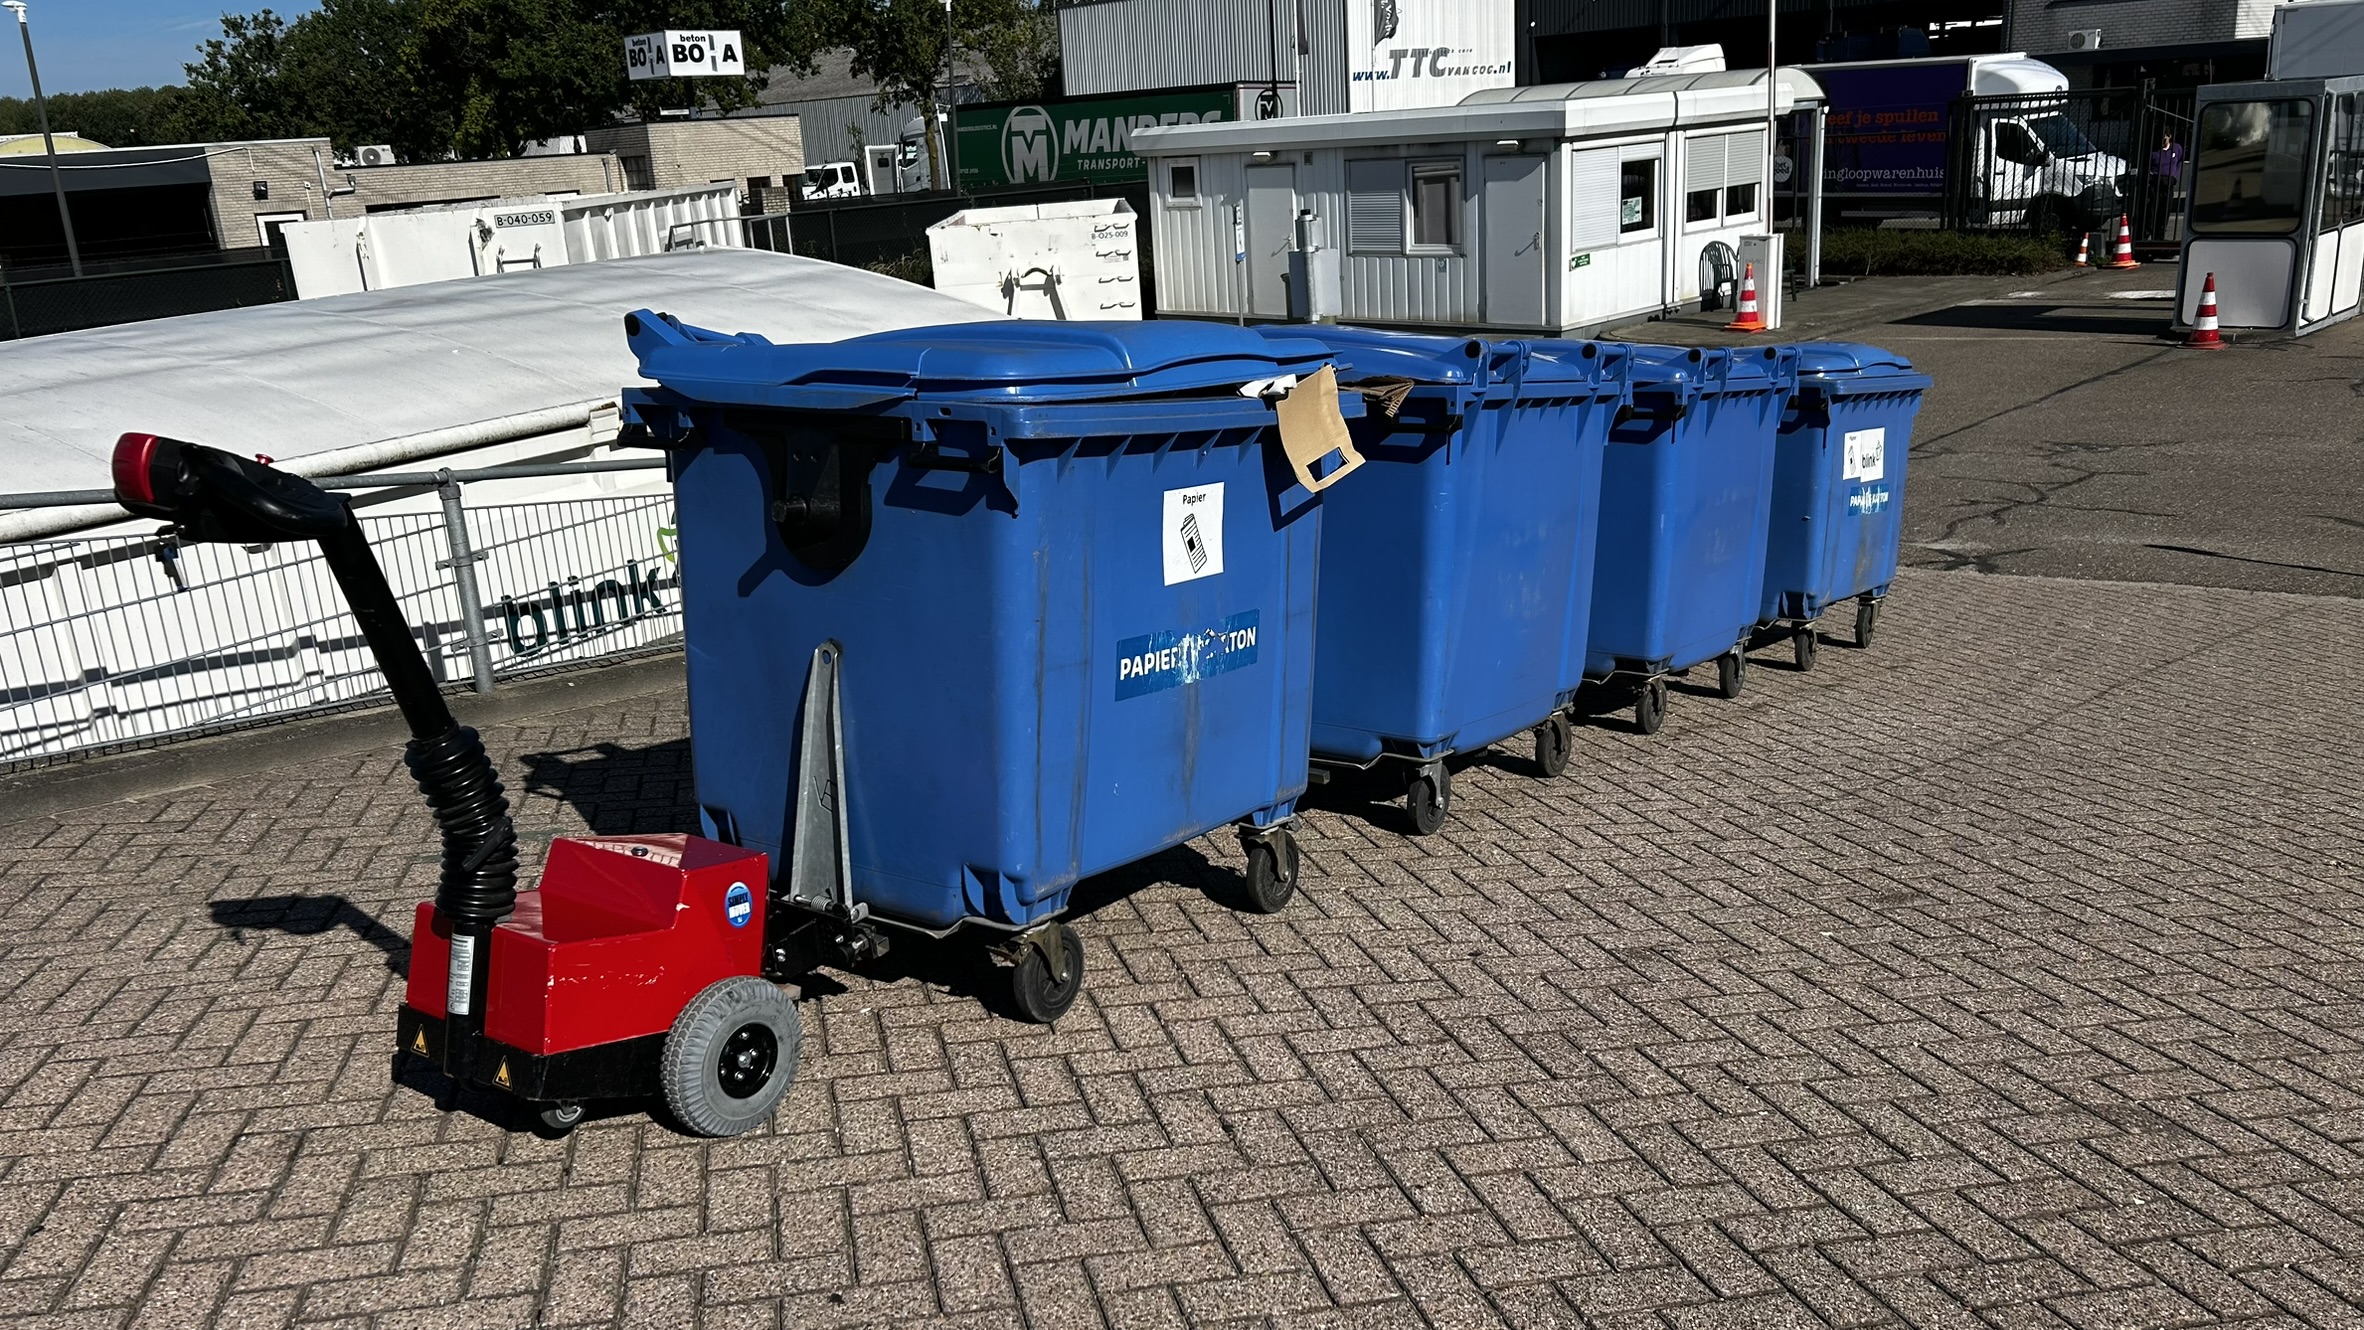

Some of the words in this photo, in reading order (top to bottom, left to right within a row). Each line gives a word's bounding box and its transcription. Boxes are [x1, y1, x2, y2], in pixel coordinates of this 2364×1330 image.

[680, 34, 706, 42] beton
[1827, 111, 1853, 125] eef
[1855, 111, 1871, 128] je
[1875, 109, 1939, 127] spullen
[1824, 166, 1945, 182] ingloopwarenhuis
[496, 212, 552, 226] B-040-059
[1182, 492, 1207, 506] Papier
[501, 559, 667, 658] blink
